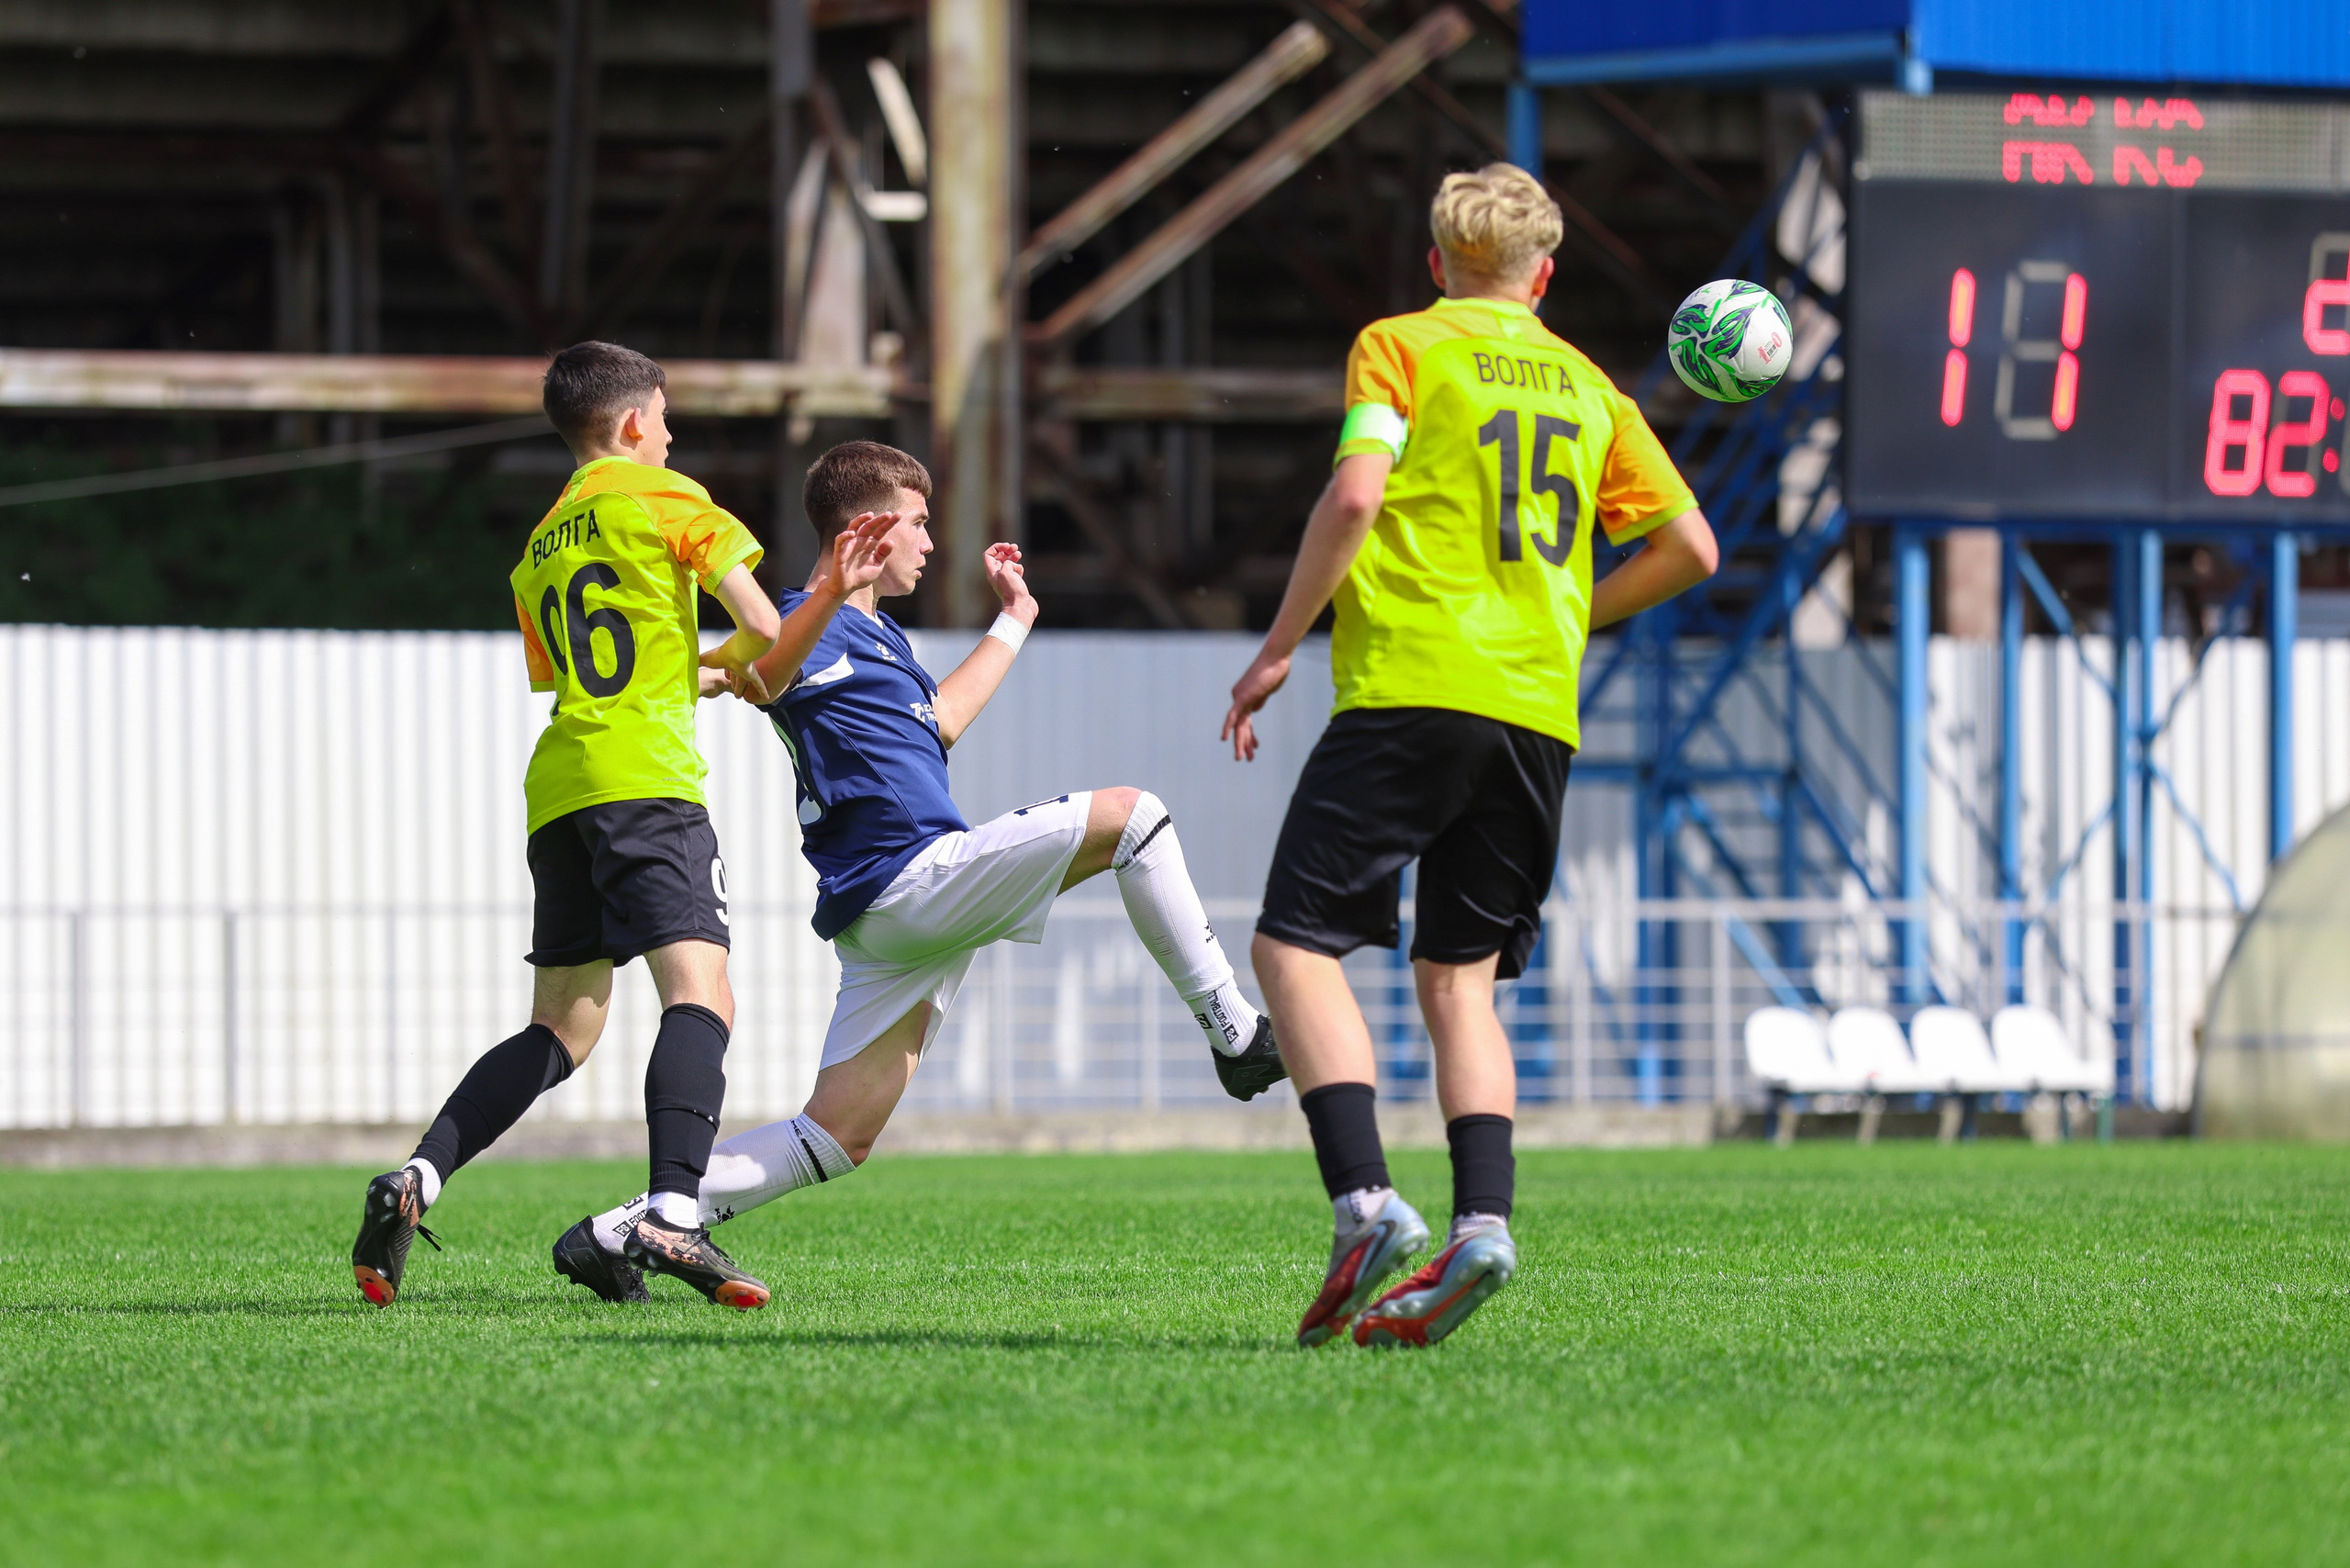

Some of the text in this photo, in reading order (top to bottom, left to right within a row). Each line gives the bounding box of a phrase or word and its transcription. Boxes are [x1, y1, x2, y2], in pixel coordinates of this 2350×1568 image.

[1472, 352, 1576, 398] ВОЛГА
[1479, 409, 1581, 567] 15
[532, 510, 600, 570] ВОЛГА
